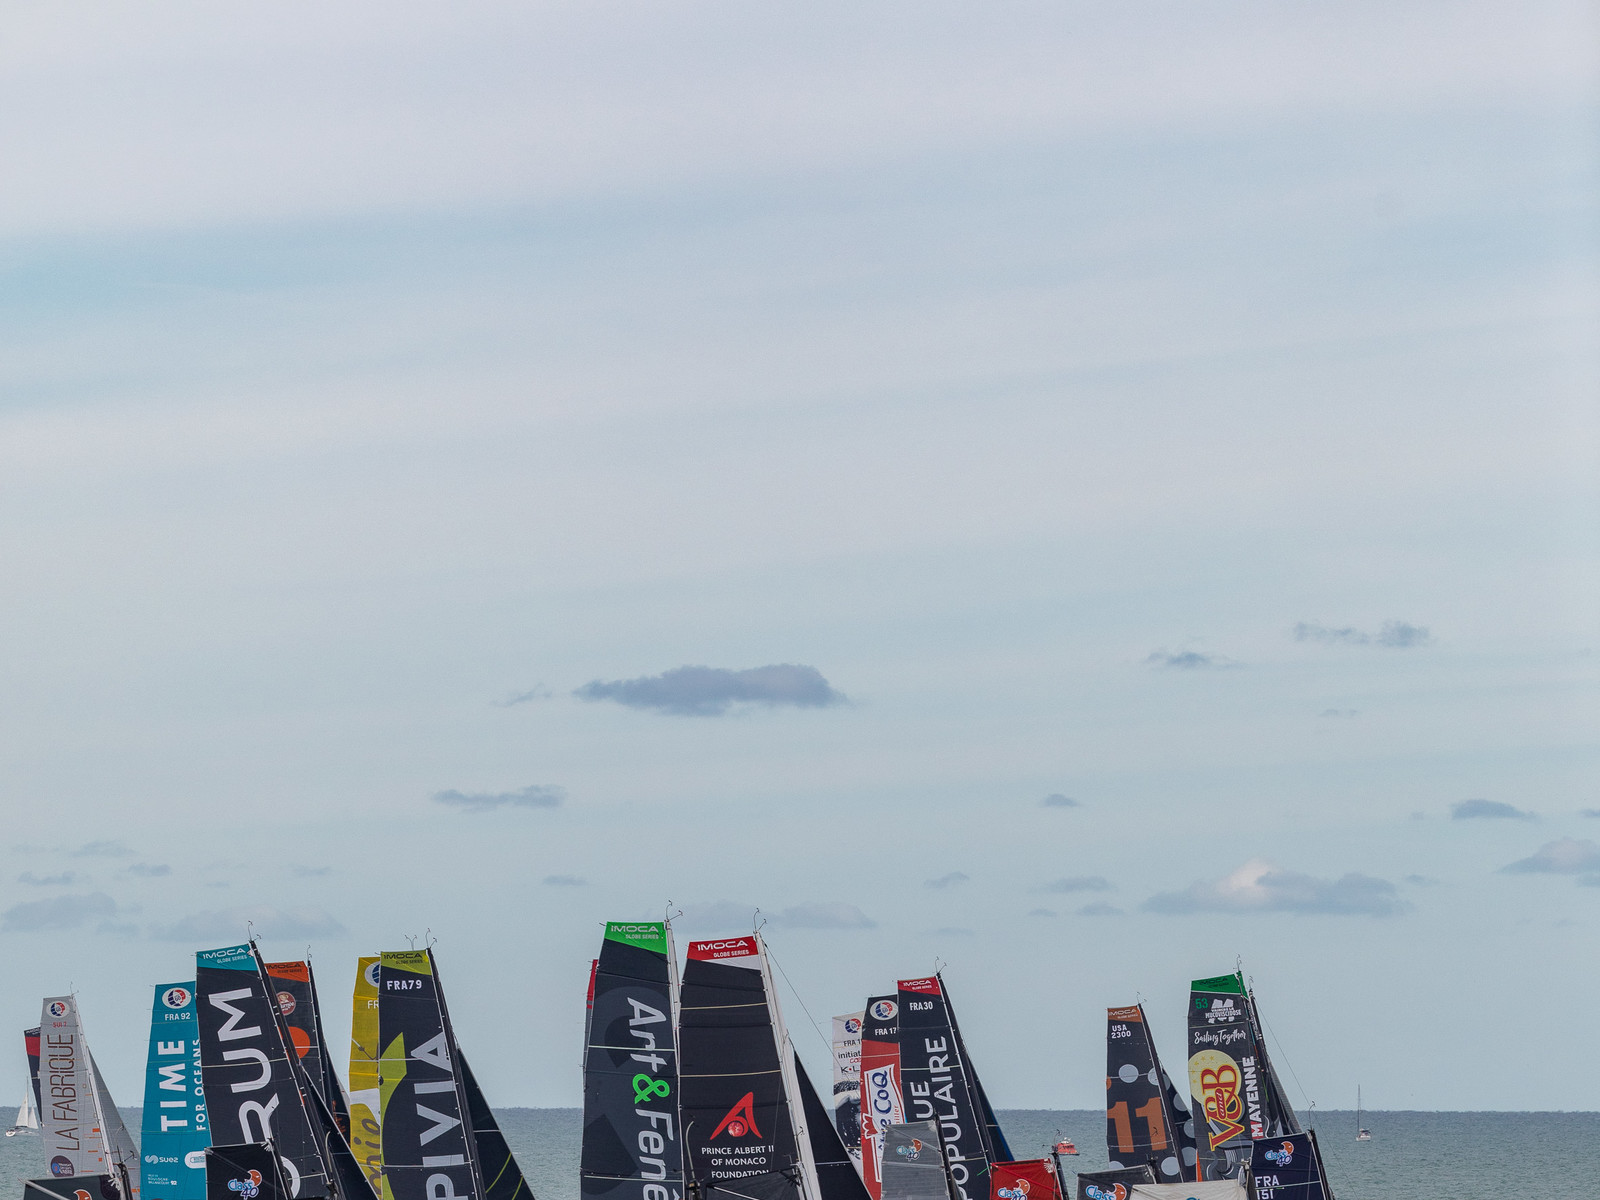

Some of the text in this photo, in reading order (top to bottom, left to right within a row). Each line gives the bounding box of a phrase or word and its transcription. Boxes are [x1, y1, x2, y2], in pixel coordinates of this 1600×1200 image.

[610, 924, 659, 933] IMOCA
[697, 940, 749, 951] IMOCA
[203, 947, 246, 959] IMOCA
[384, 952, 423, 960] IMOCA
[1195, 998, 1209, 1010] 53
[164, 1012, 191, 1021] FRA 92
[874, 1027, 888, 1036] FRA
[1111, 1024, 1128, 1032] USA
[627, 996, 667, 1073] Art
[1111, 1030, 1132, 1039] 2300
[46, 1033, 79, 1121] FABRIQUE
[157, 1040, 188, 1132] TIME
[191, 1038, 207, 1131] FOR OCEANS
[631, 1073, 670, 1105] &
[1241, 1055, 1265, 1140] MAYENNE
[55, 1126, 80, 1151] LA
[701, 1145, 774, 1155] PRINCE ALBERT II
[1265, 1149, 1287, 1161] Class
[711, 1156, 767, 1166] OF MONACO
[1276, 1154, 1293, 1168] 40
[228, 1178, 253, 1192] Class
[1254, 1174, 1280, 1188] FRA
[240, 1185, 260, 1200] 40
[998, 1187, 1021, 1200] Class
[1256, 1188, 1275, 1200] 151
